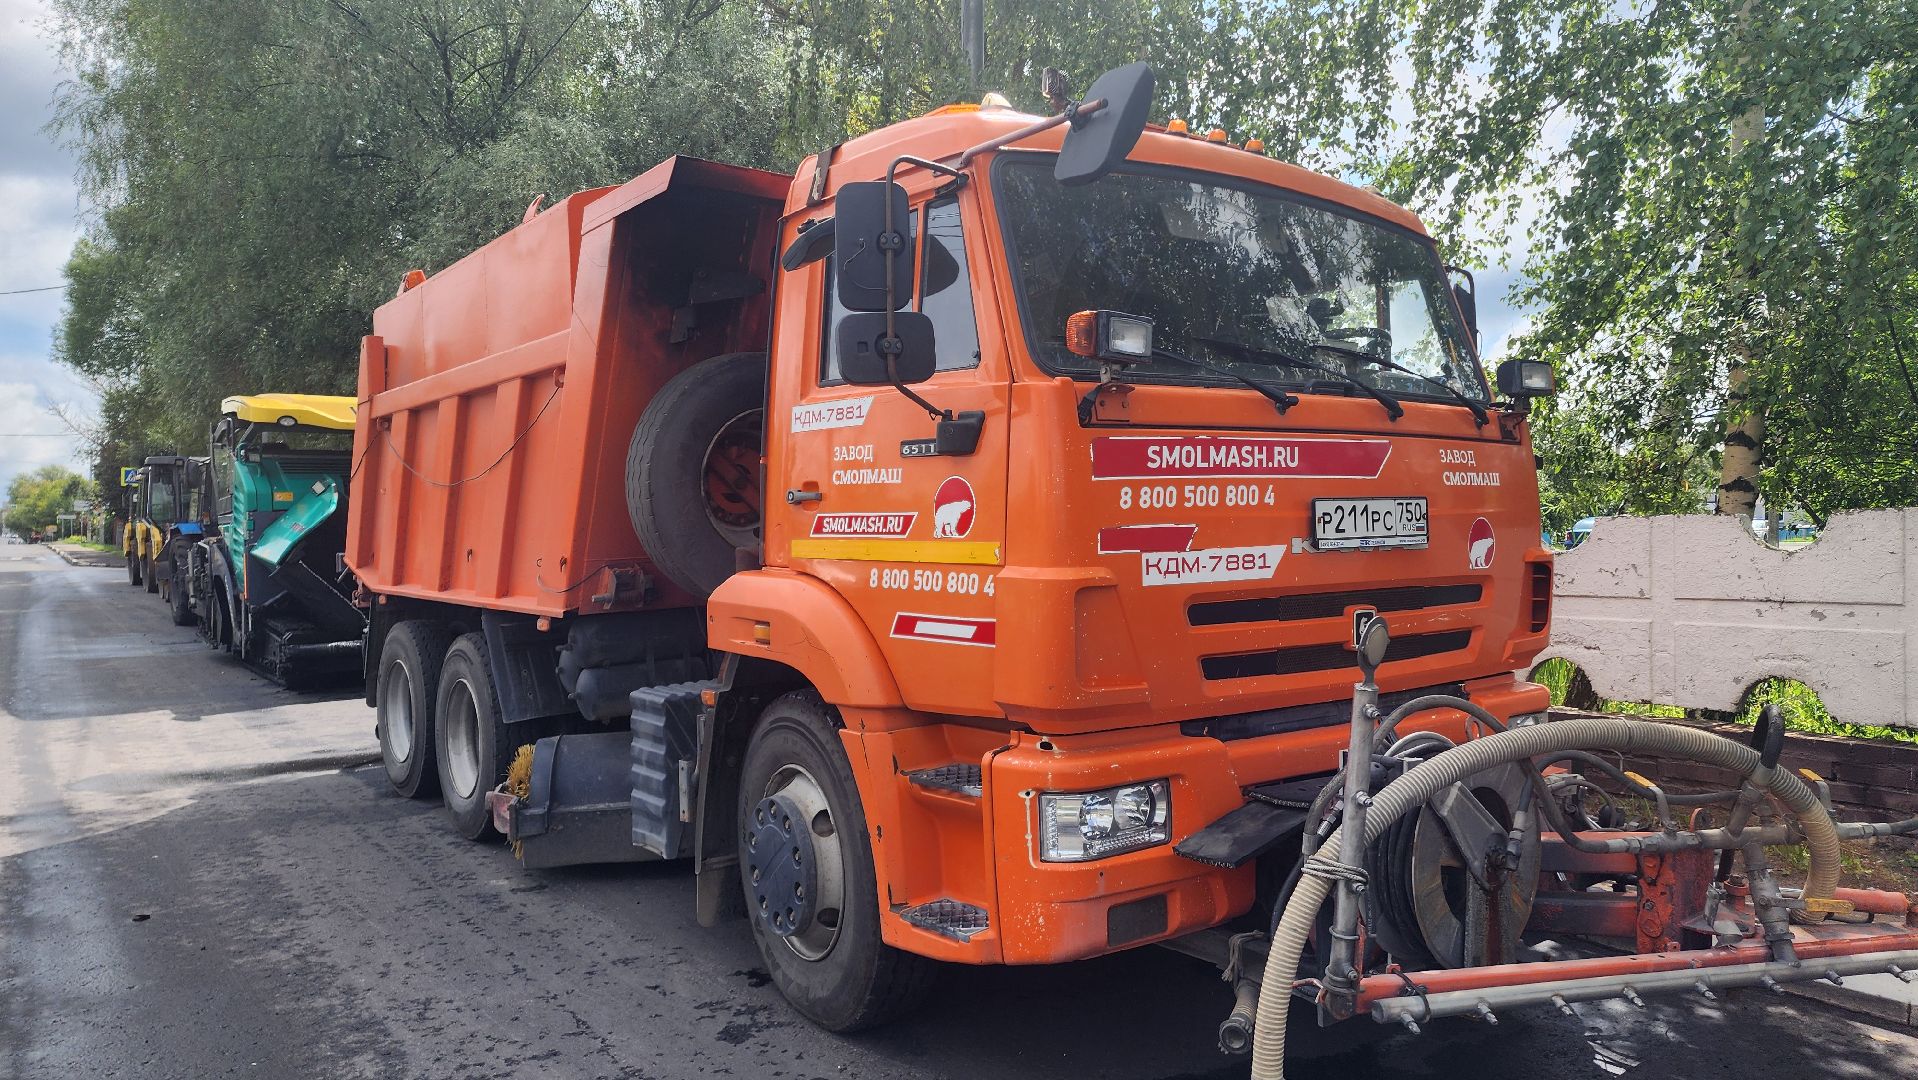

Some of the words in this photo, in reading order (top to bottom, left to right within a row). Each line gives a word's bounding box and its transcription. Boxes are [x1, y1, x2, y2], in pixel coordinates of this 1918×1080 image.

[795, 405, 864, 428] КДМ-7881
[834, 445, 873, 463] ЗАВОД
[1147, 445, 1299, 468] SMOLMASH.RU
[1440, 449, 1476, 467] ЗАВОД
[832, 468, 902, 485] СМОЛМАШ
[1443, 471, 1500, 486] СМОЛМАШ
[1119, 486, 1132, 510] 8
[1139, 486, 1177, 508] 800
[1184, 485, 1219, 508] 500
[1225, 484, 1259, 506] 800
[1264, 484, 1275, 506] 4
[1396, 502, 1421, 523] 750
[822, 516, 904, 533] SMOLMASH.RU
[1402, 523, 1416, 532] RUS
[1145, 552, 1272, 578] КДМ-7881
[869, 568, 878, 588] 8
[882, 568, 909, 590] 800
[913, 569, 942, 592] 500
[947, 571, 979, 595] 800
[983, 574, 995, 597] 4
